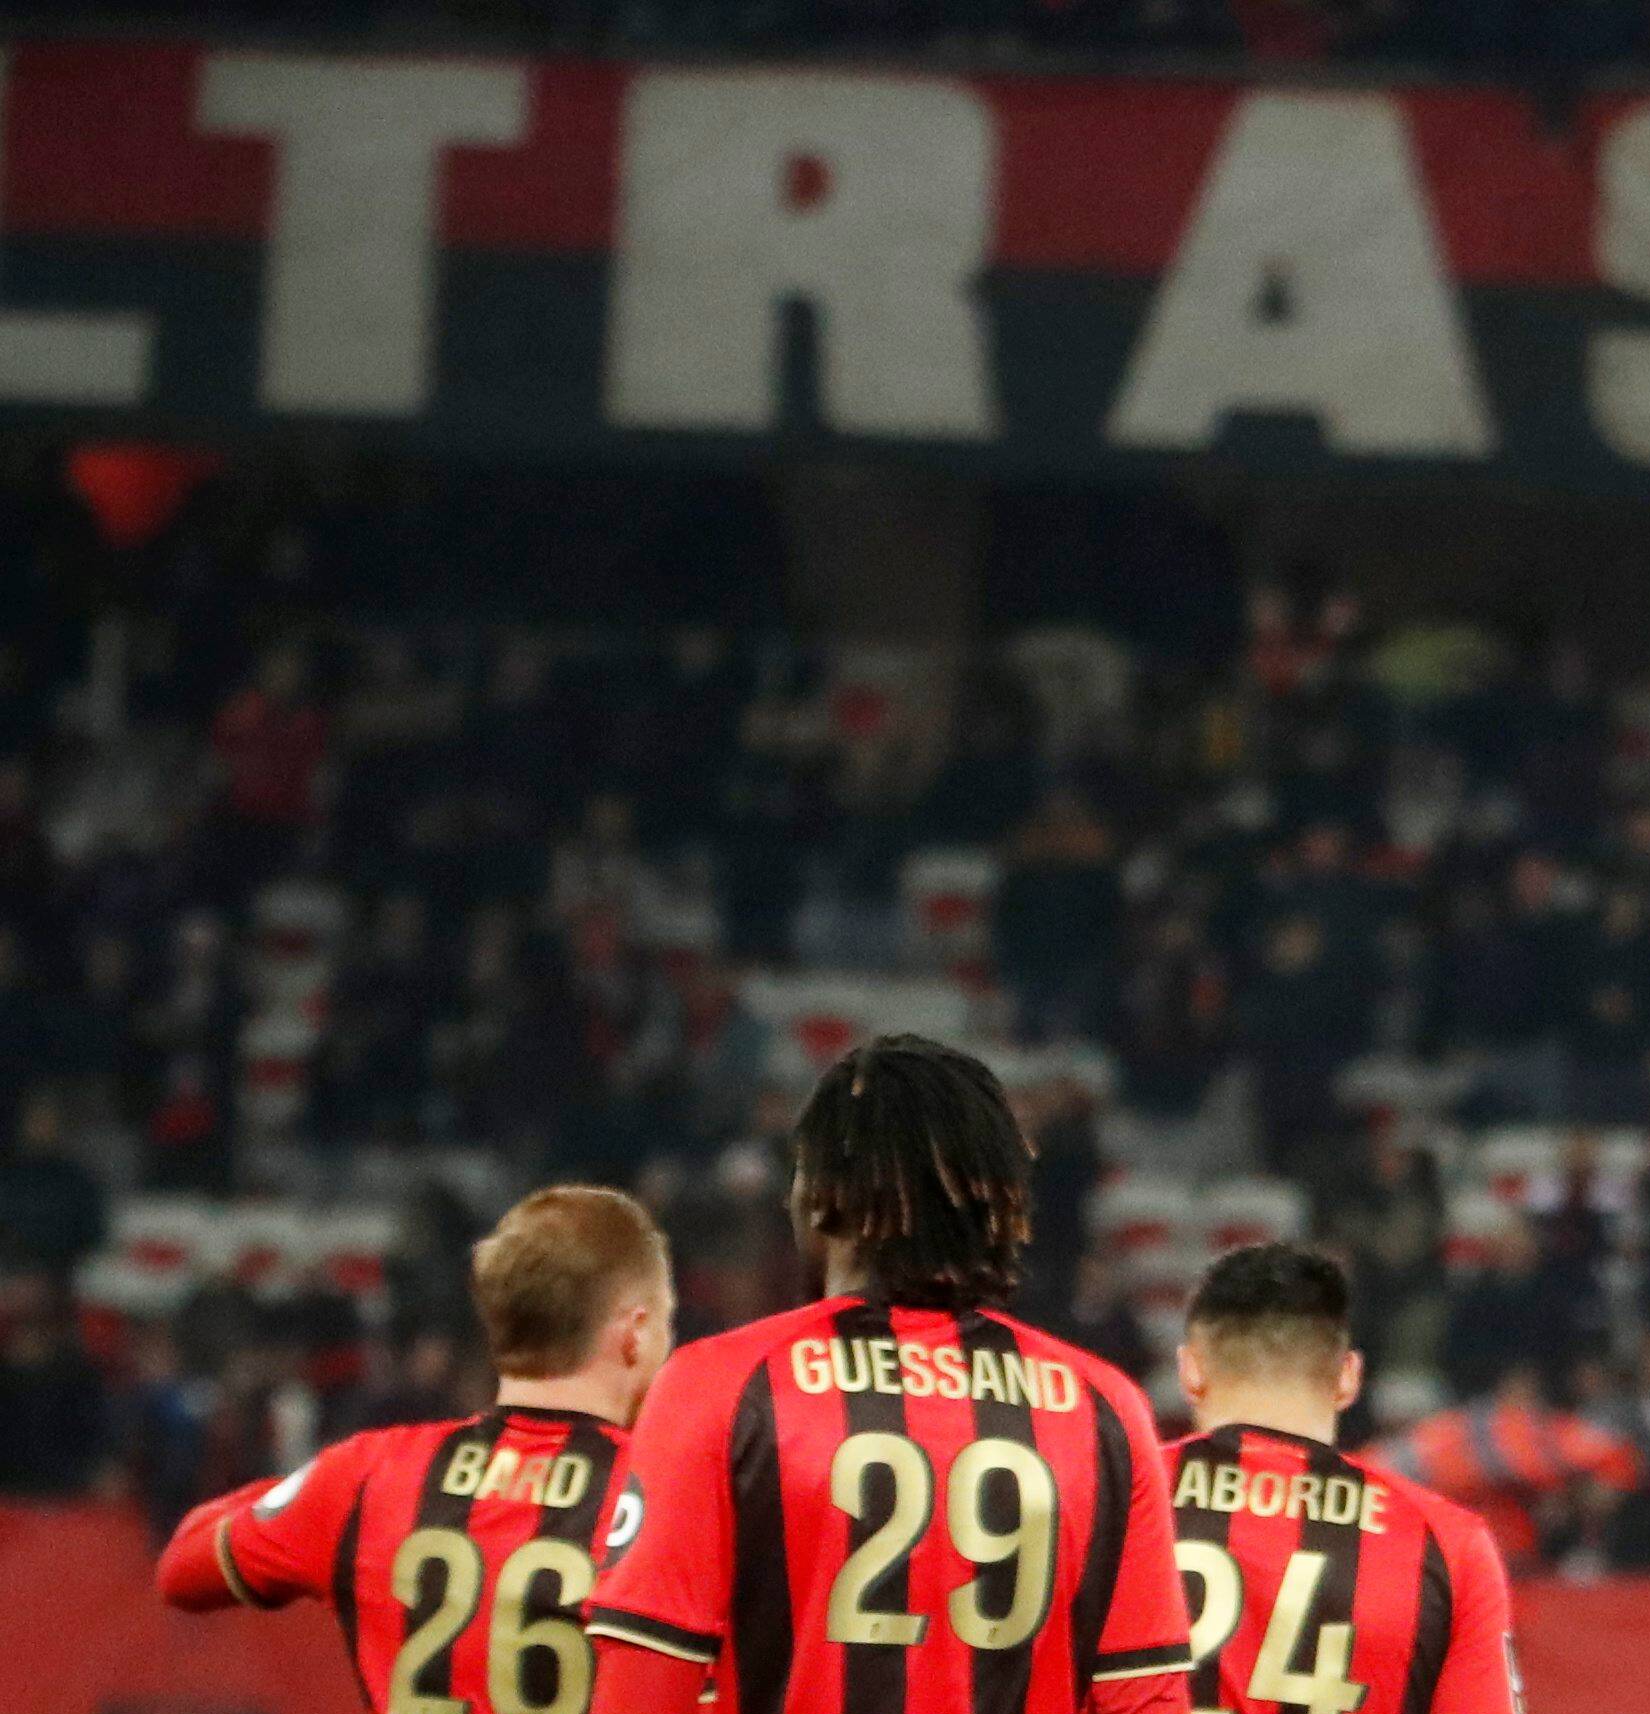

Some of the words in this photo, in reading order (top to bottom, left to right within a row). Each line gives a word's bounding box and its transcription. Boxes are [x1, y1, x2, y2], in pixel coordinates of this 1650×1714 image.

[791, 1336, 1081, 1414] GUESSAND
[441, 1441, 593, 1508] BARD
[1173, 1457, 1389, 1534] ABORDE
[827, 1431, 1059, 1651] 29
